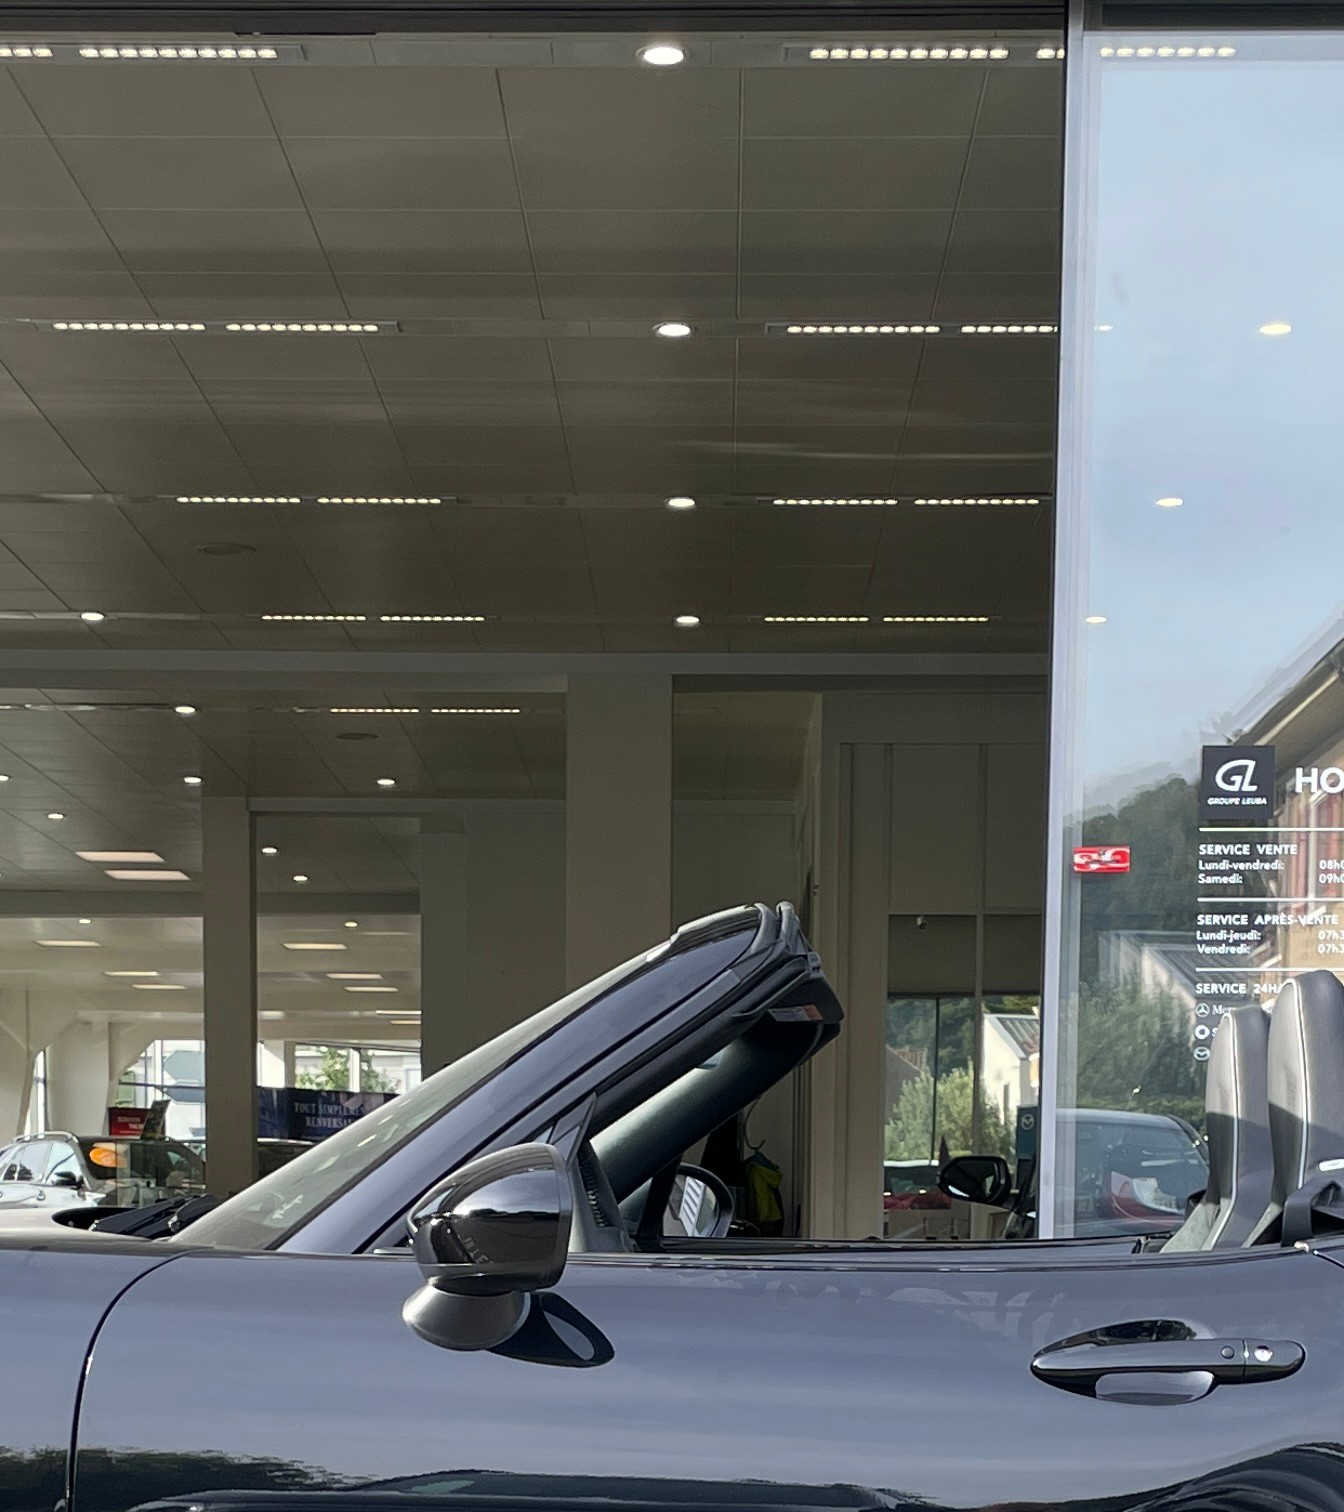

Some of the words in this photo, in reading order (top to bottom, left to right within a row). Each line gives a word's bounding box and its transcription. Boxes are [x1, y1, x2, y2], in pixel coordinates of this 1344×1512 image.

[1207, 797, 1240, 805] GROUPE
[1198, 844, 1250, 855] SERVICE
[1256, 844, 1297, 855] VENTE
[1197, 914, 1248, 925] SERVICE
[1254, 911, 1339, 925] APRÈS-VENTE
[1195, 983, 1246, 994] SERVICE
